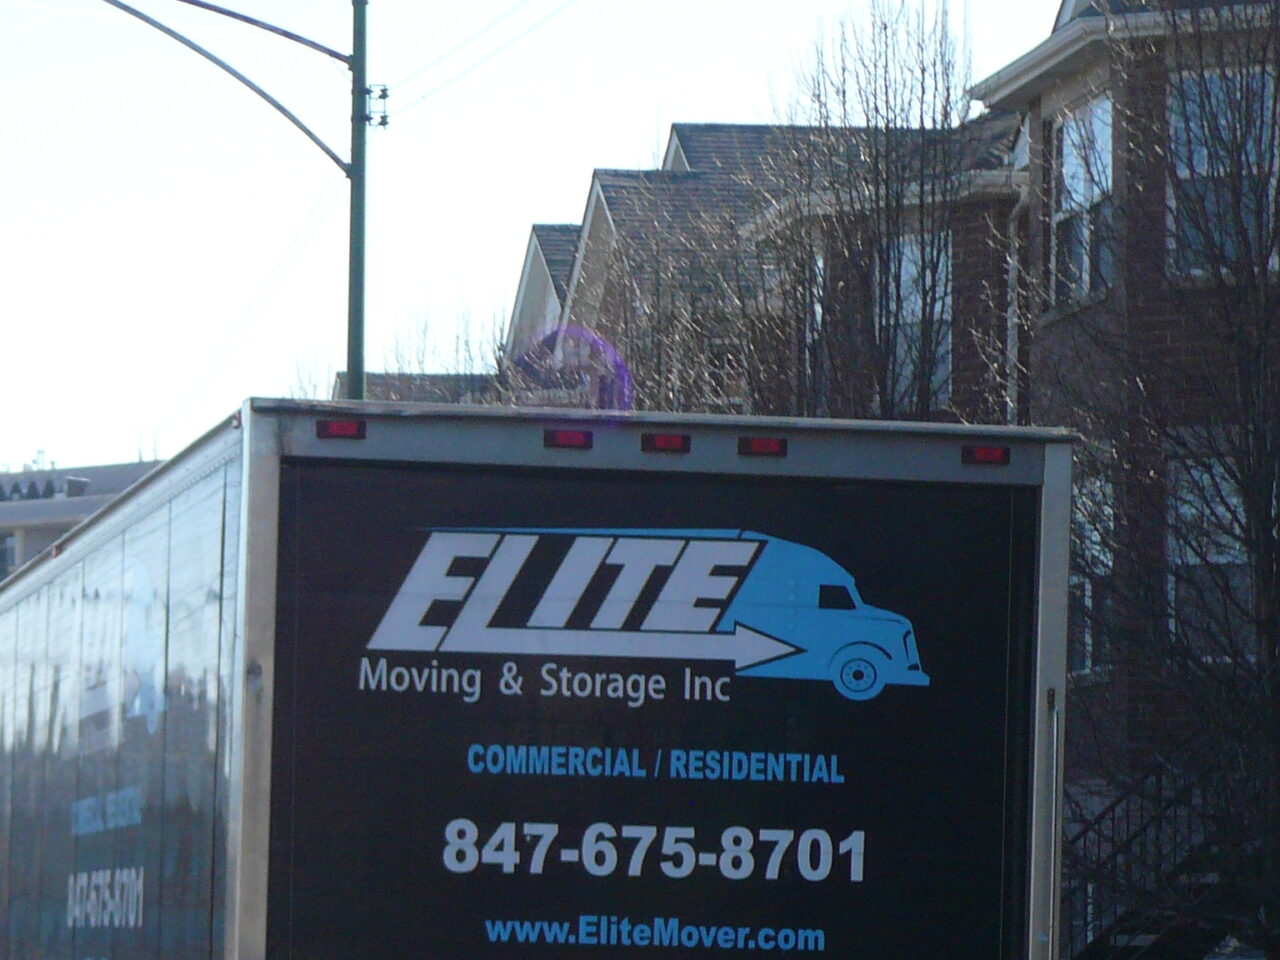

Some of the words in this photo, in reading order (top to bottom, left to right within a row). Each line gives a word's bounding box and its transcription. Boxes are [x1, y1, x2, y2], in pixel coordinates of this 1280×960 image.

[366, 531, 760, 652] ELITE
[358, 657, 481, 702] Moving
[499, 661, 523, 695] &
[540, 662, 666, 707] Storage
[684, 667, 730, 702] Inc
[467, 744, 646, 778] COMMERCIAL
[670, 749, 845, 784] RESIDENTIAL
[442, 819, 867, 883] 847-675-8701
[485, 915, 826, 951] www.EliteMover.com
